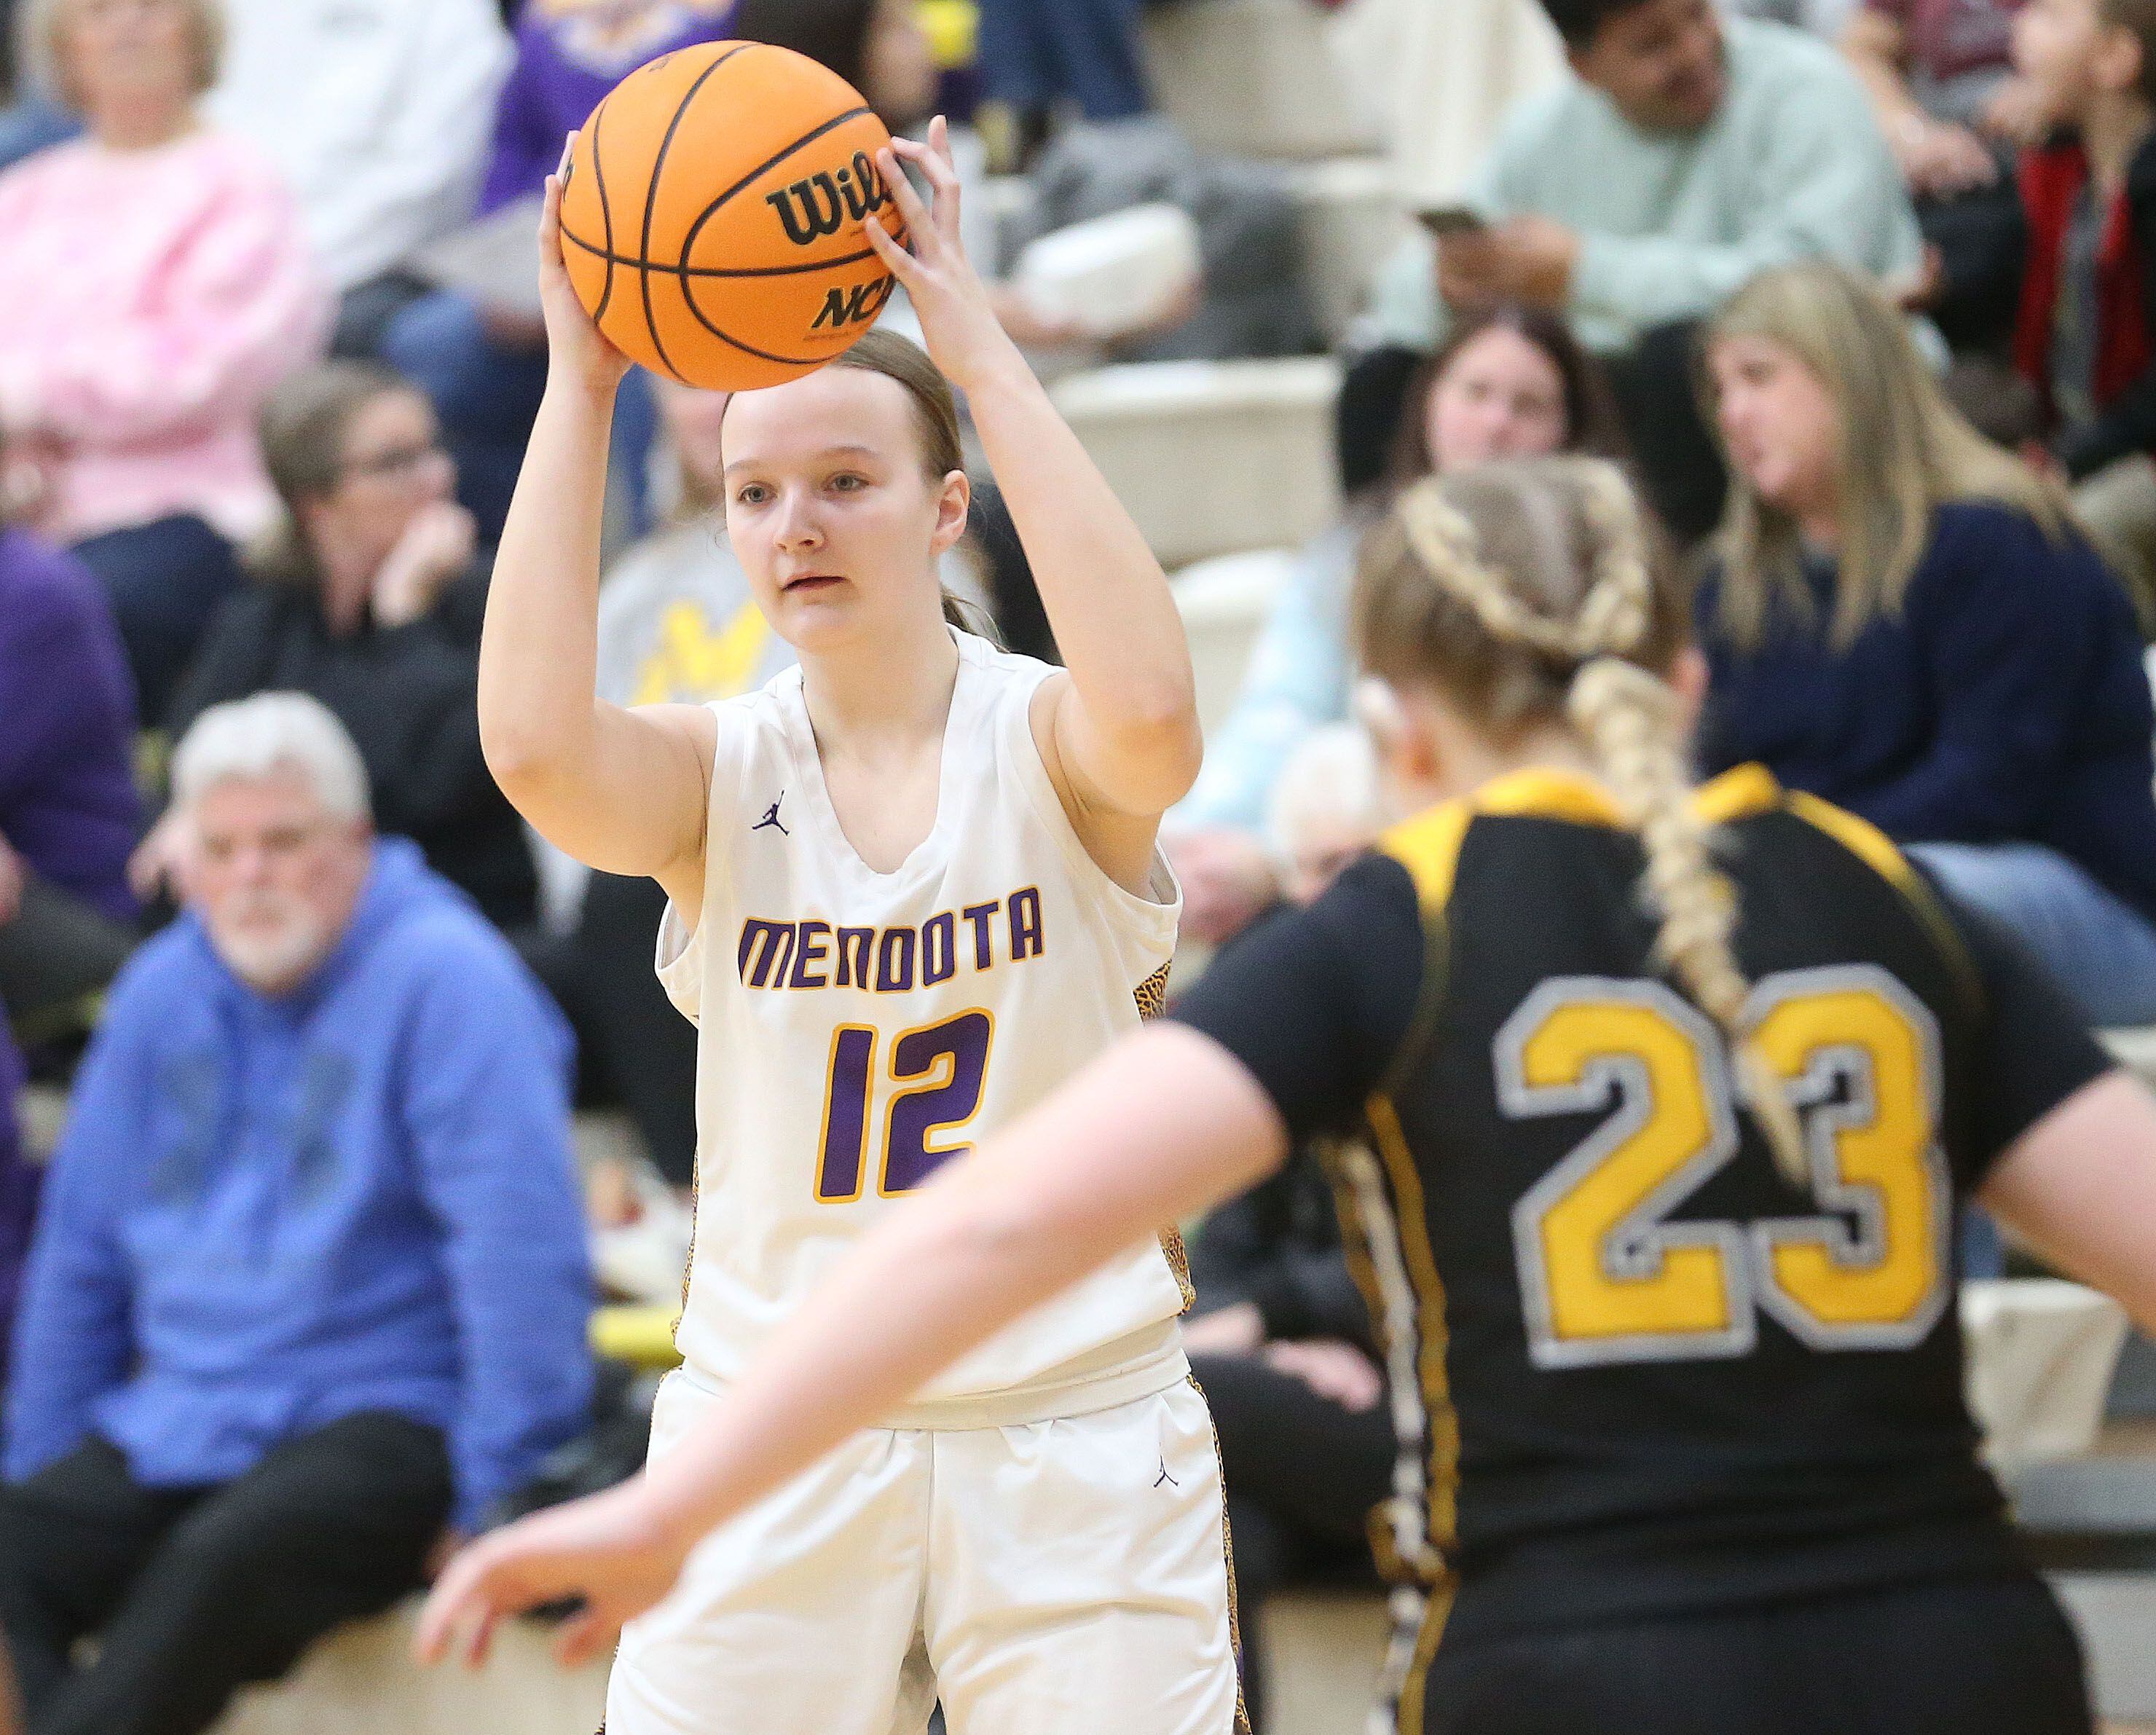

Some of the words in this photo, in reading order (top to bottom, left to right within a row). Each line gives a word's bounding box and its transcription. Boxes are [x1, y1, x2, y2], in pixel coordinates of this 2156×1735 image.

[766, 150, 893, 245] Wil
[738, 884, 1045, 993] MENDOTA
[814, 1006, 996, 1204] 12
[1490, 961, 1954, 1371] 23
